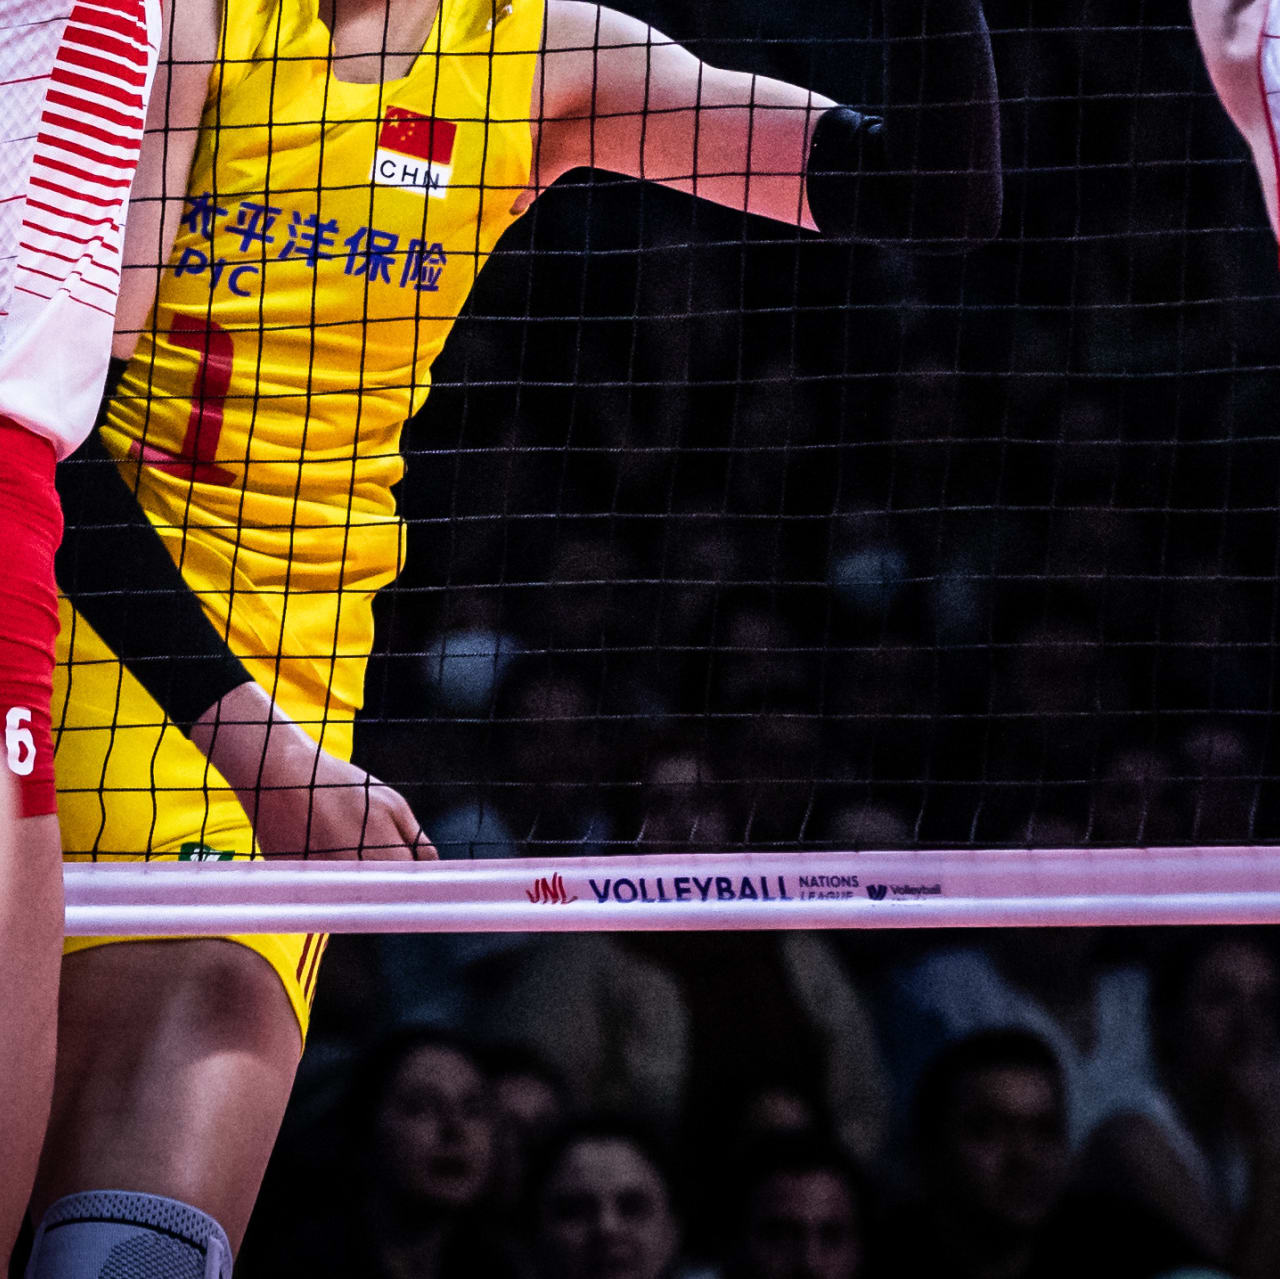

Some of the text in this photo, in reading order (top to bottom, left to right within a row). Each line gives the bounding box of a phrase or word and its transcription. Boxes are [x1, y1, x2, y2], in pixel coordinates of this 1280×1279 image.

[380, 160, 440, 189] CHN
[5, 706, 37, 776] 6
[589, 875, 793, 903] VOLLEYBALL
[799, 875, 859, 888] NATIONS
